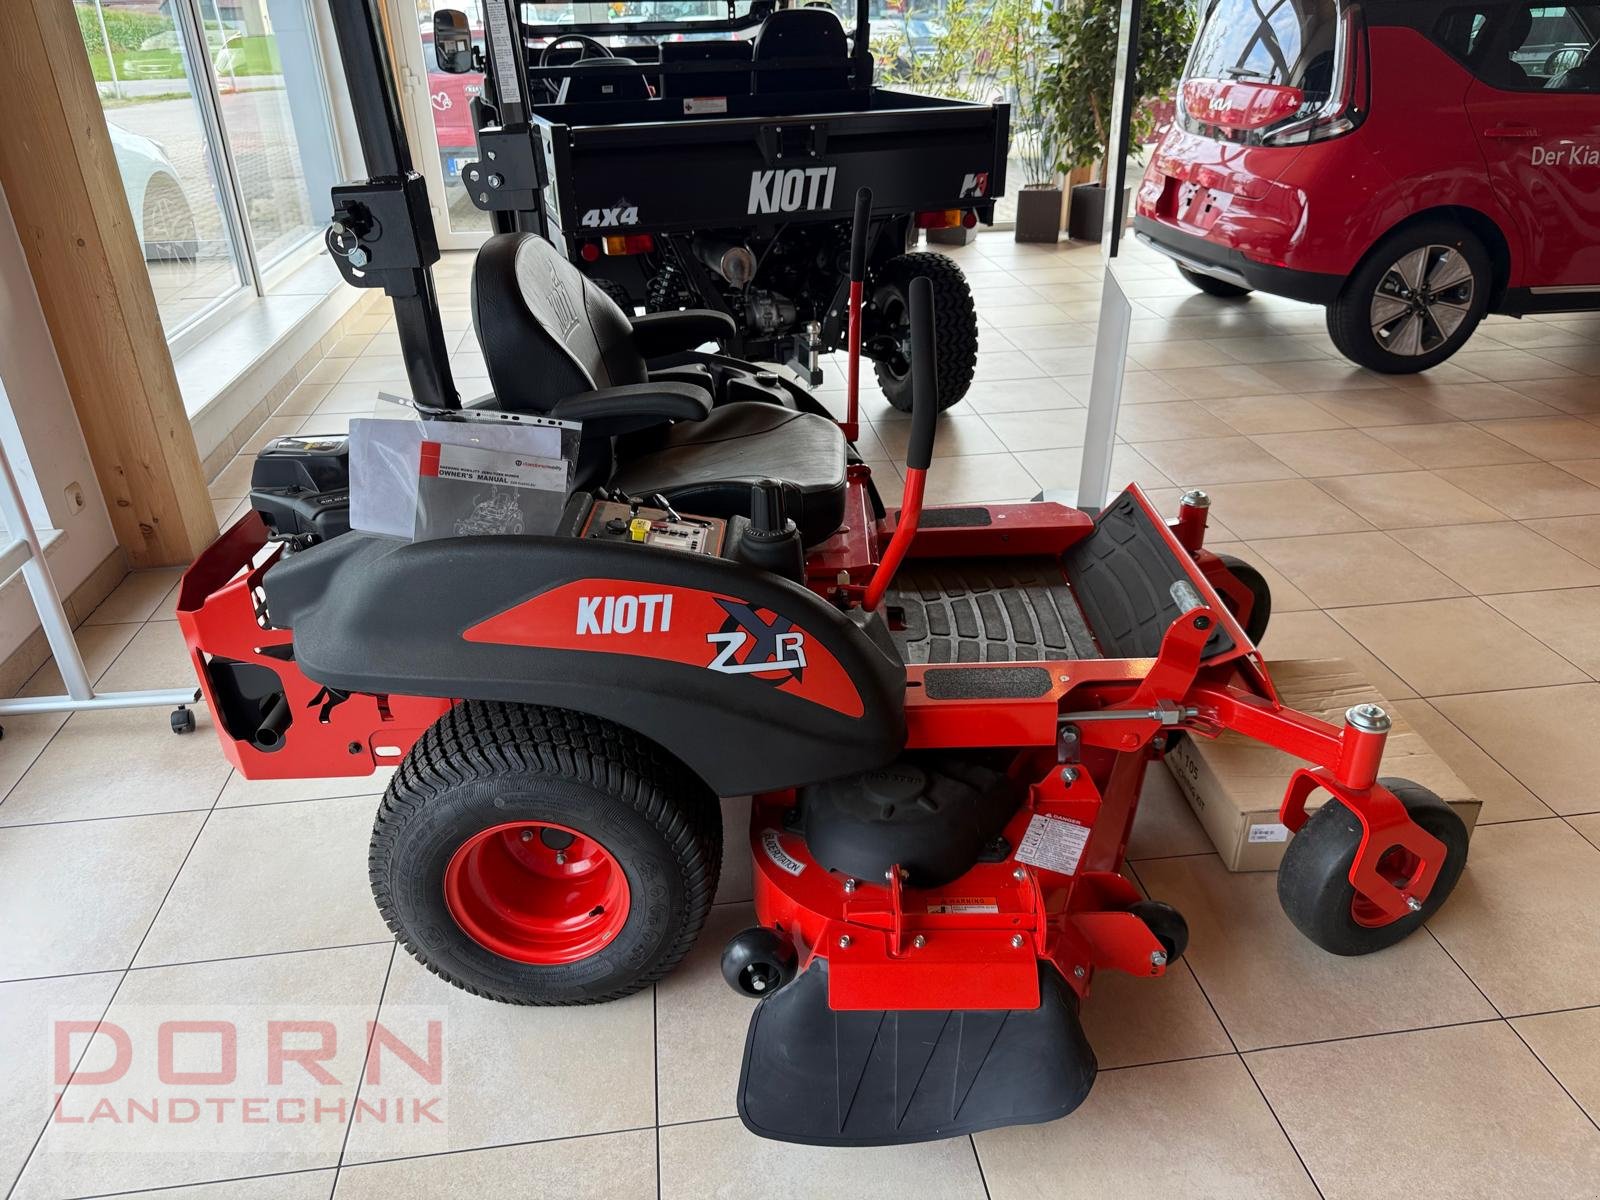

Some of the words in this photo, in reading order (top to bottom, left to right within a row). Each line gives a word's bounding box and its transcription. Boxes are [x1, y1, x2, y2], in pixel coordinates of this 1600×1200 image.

[1531, 146, 1565, 166] Der
[1568, 145, 1600, 166] Kia
[747, 166, 837, 215] KIOTI
[438, 469, 473, 480] OWNER'S
[477, 474, 509, 484] MANUAL
[575, 593, 674, 635] KIOTI
[1185, 754, 1199, 780] 105
[1053, 813, 1082, 825] DANGER
